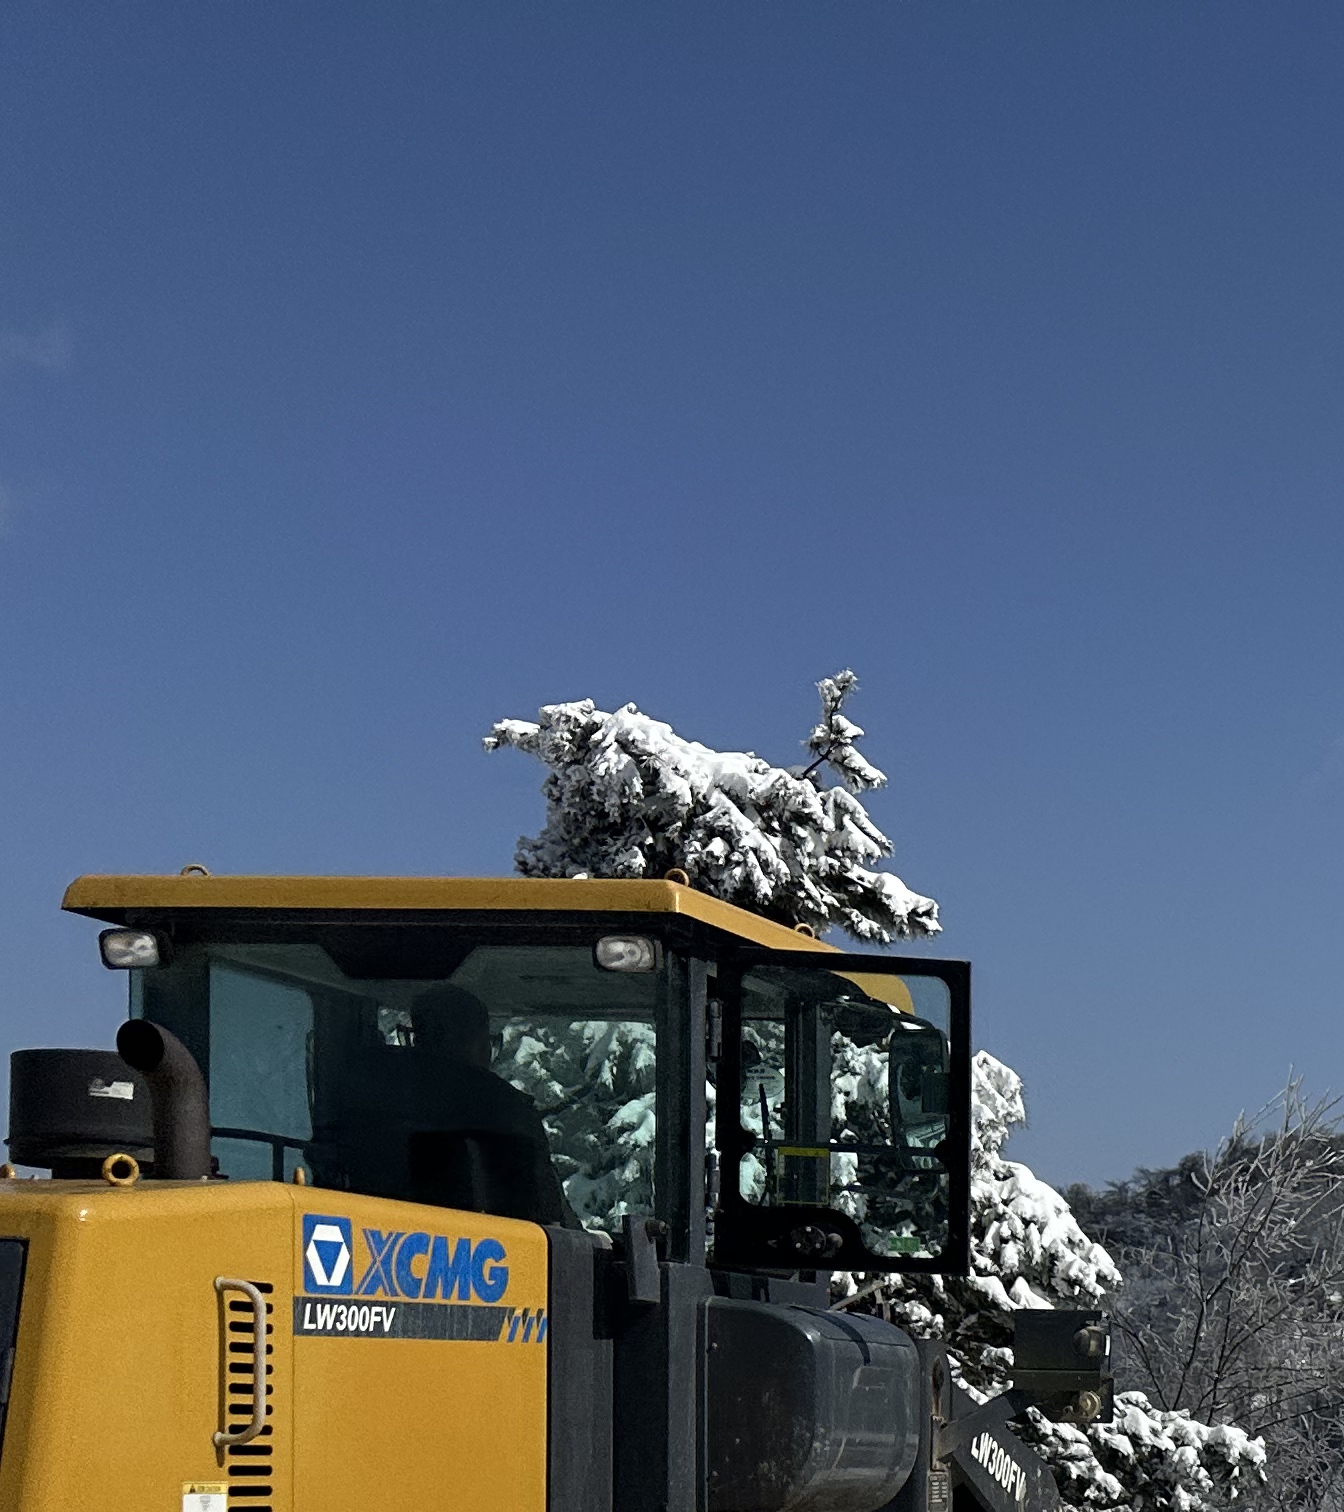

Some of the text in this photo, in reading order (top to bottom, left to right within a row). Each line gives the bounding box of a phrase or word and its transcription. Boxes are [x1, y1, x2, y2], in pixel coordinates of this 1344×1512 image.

[354, 1228, 509, 1303] XCMG
[303, 1303, 396, 1332] LW300FV
[971, 1432, 1026, 1501] LW300FV
